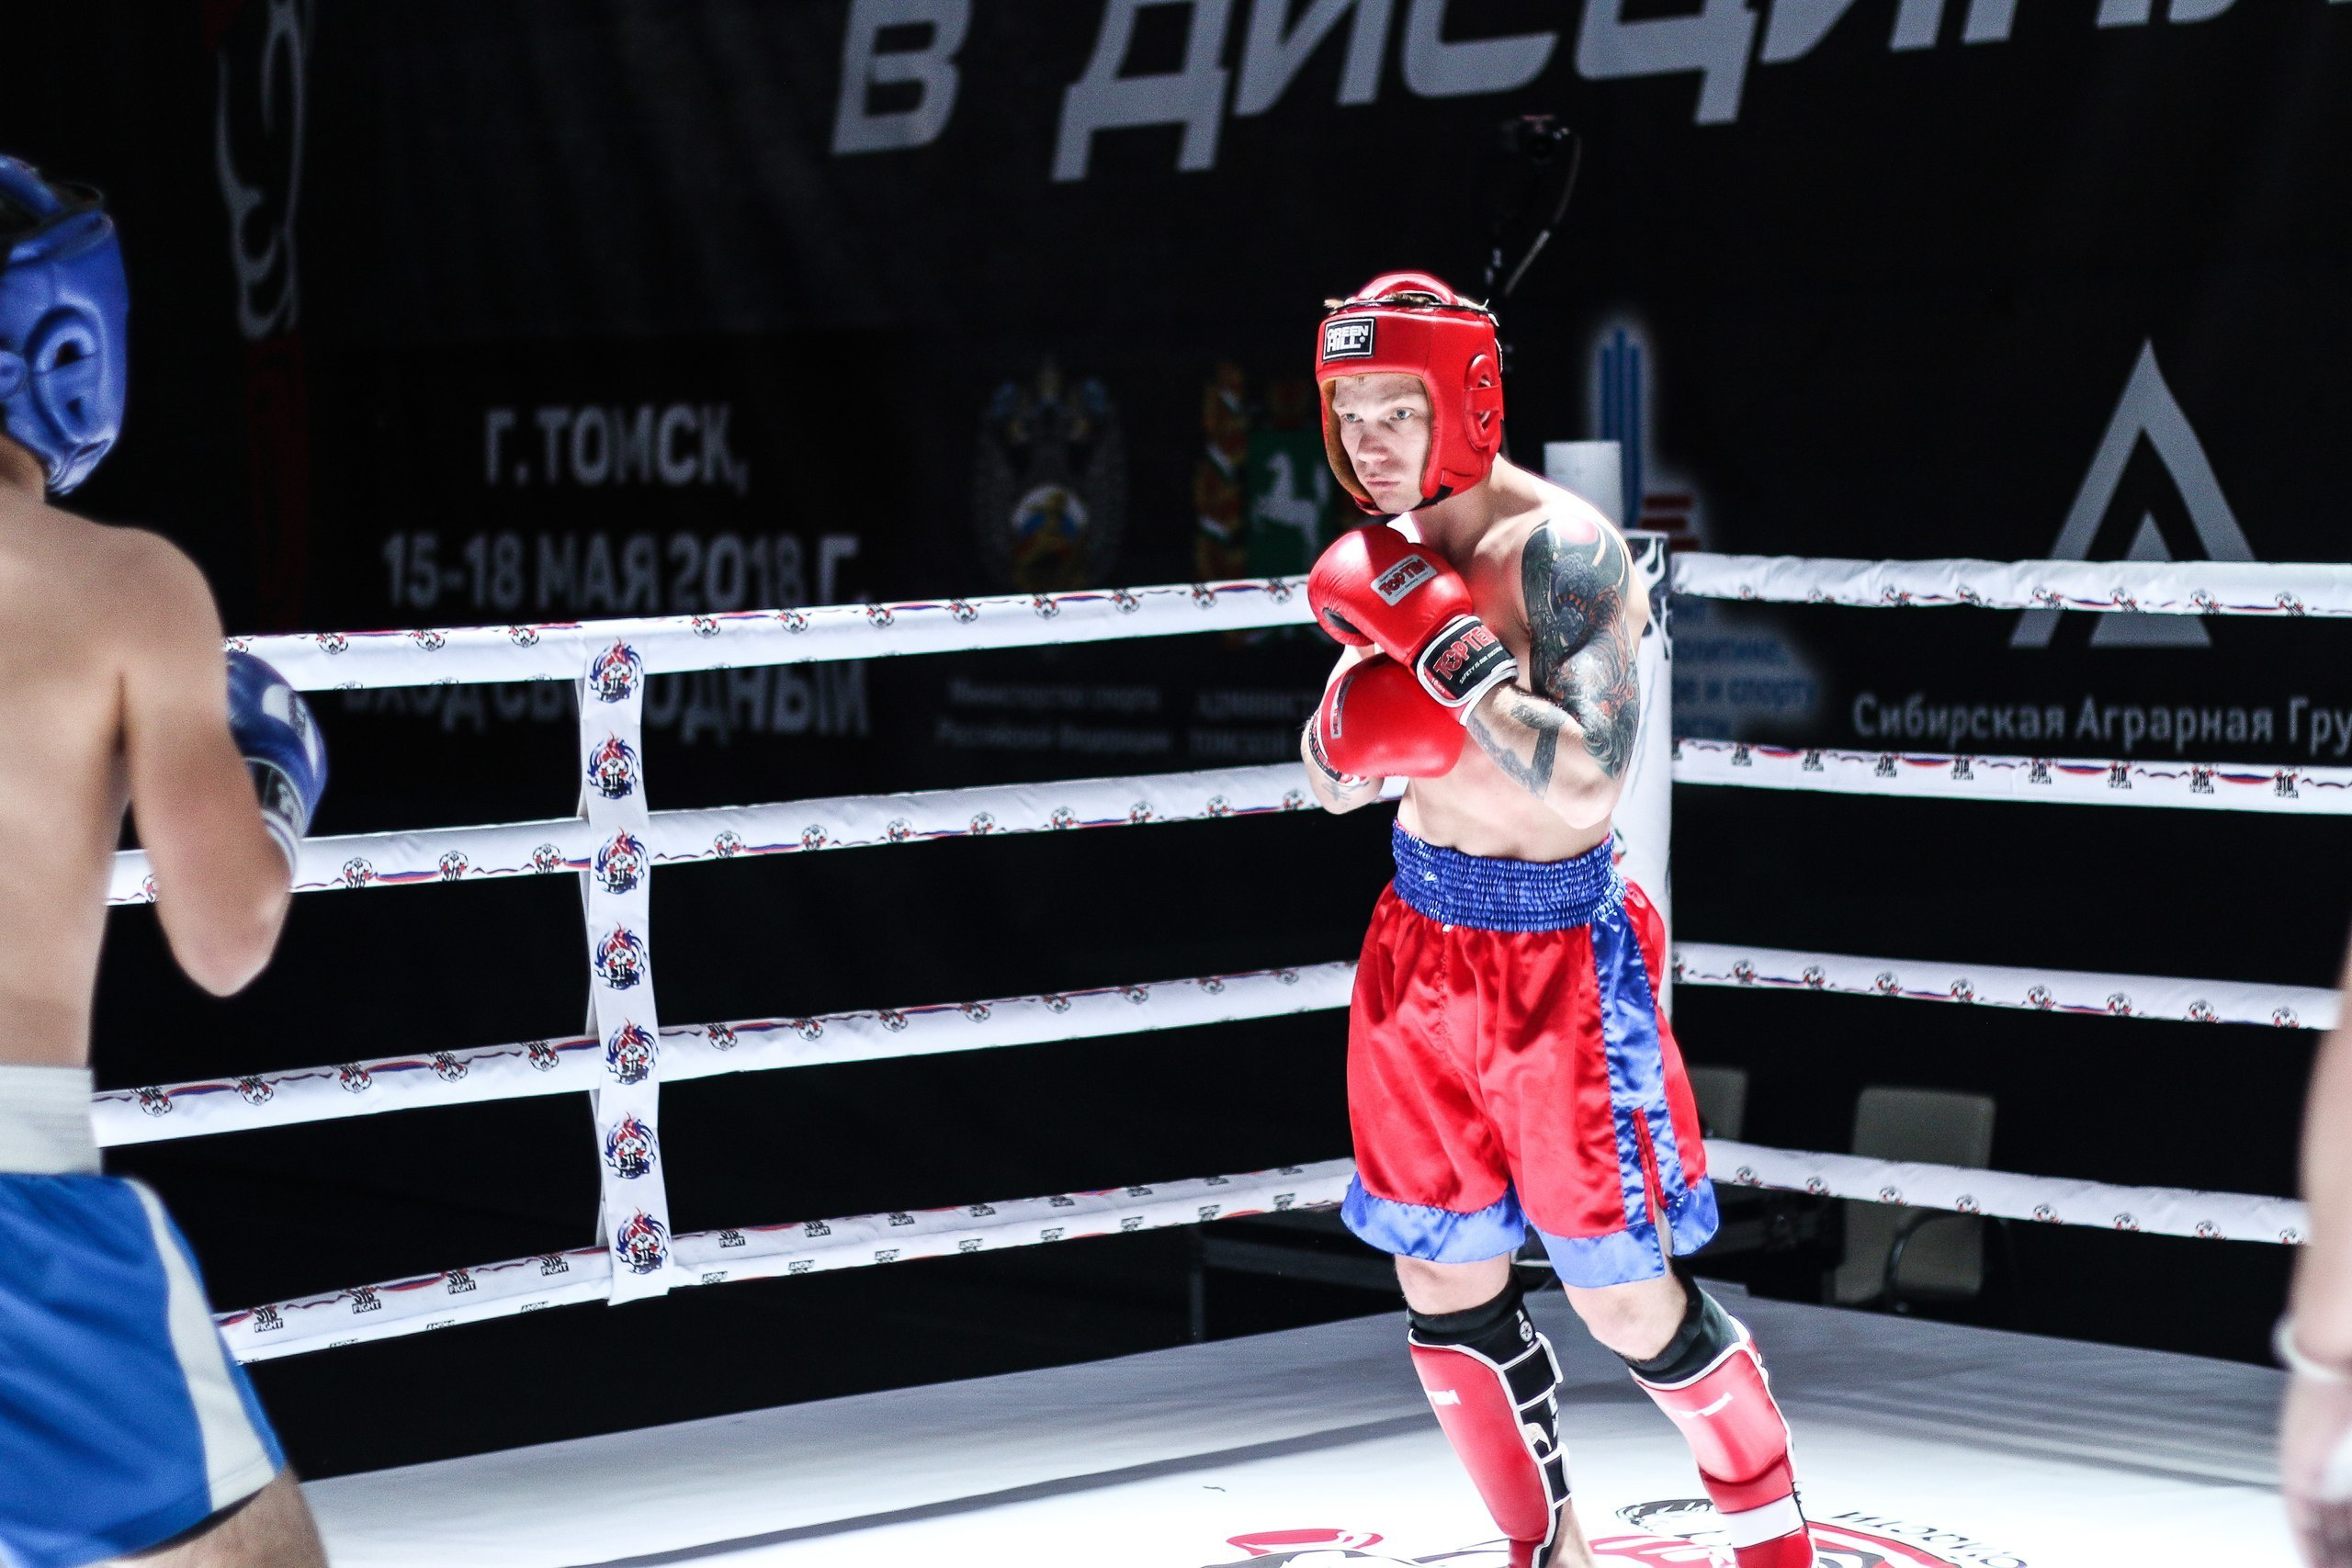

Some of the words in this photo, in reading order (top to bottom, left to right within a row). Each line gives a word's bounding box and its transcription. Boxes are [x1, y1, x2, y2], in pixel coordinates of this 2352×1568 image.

[831, 0, 973, 155] В
[535, 530, 662, 611] МАЯ
[1852, 692, 2065, 751] Сибирская
[2075, 693, 2273, 754] Аграрная
[352, 1299, 382, 1314] FIGHT
[447, 1280, 476, 1295] FIGHT
[254, 1317, 284, 1333] FIGHT
